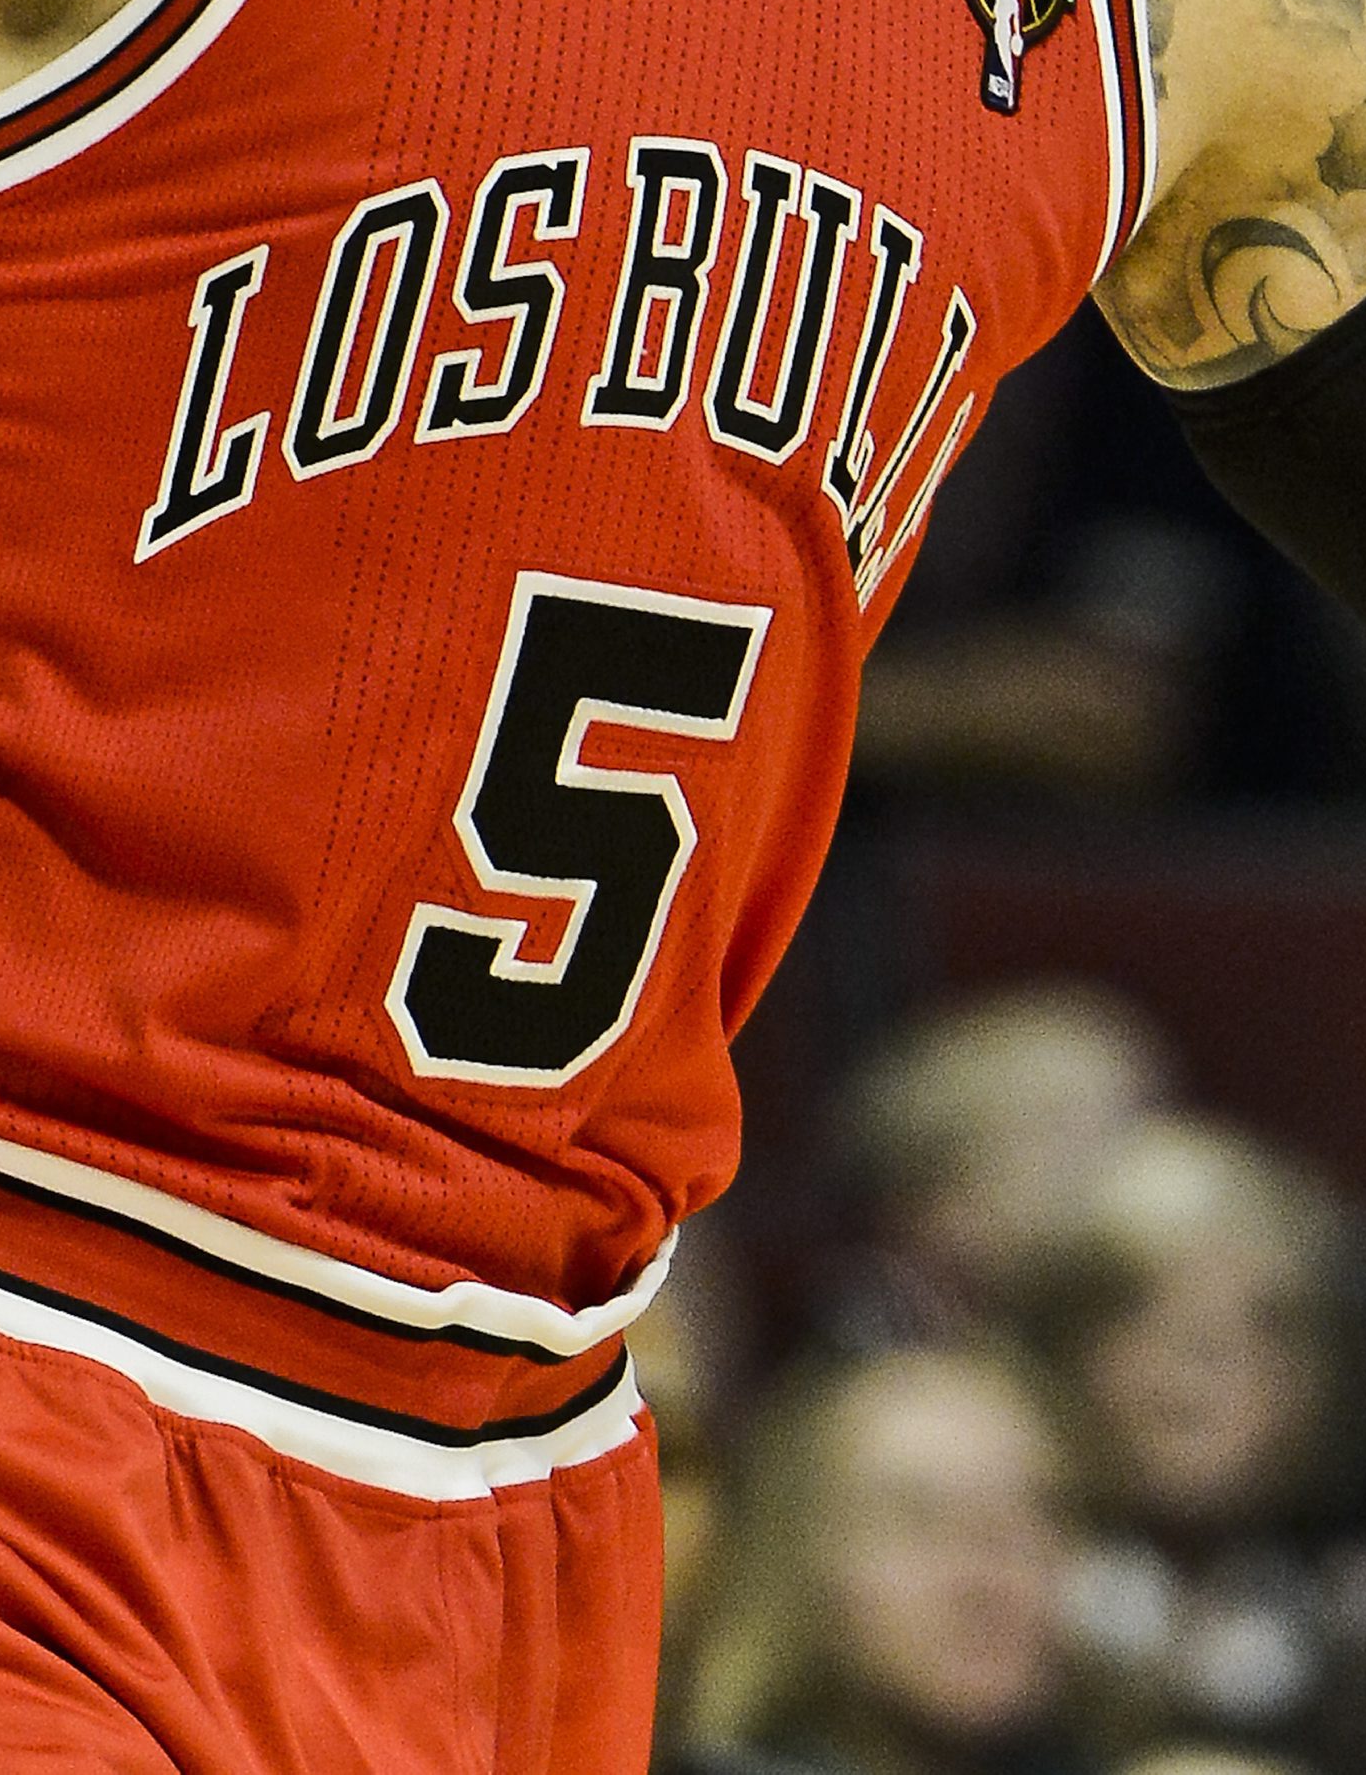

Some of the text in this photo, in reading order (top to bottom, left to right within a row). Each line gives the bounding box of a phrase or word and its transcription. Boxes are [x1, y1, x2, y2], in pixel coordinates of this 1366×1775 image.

[132, 135, 976, 614] LOS BULL
[383, 569, 774, 1089] 5
